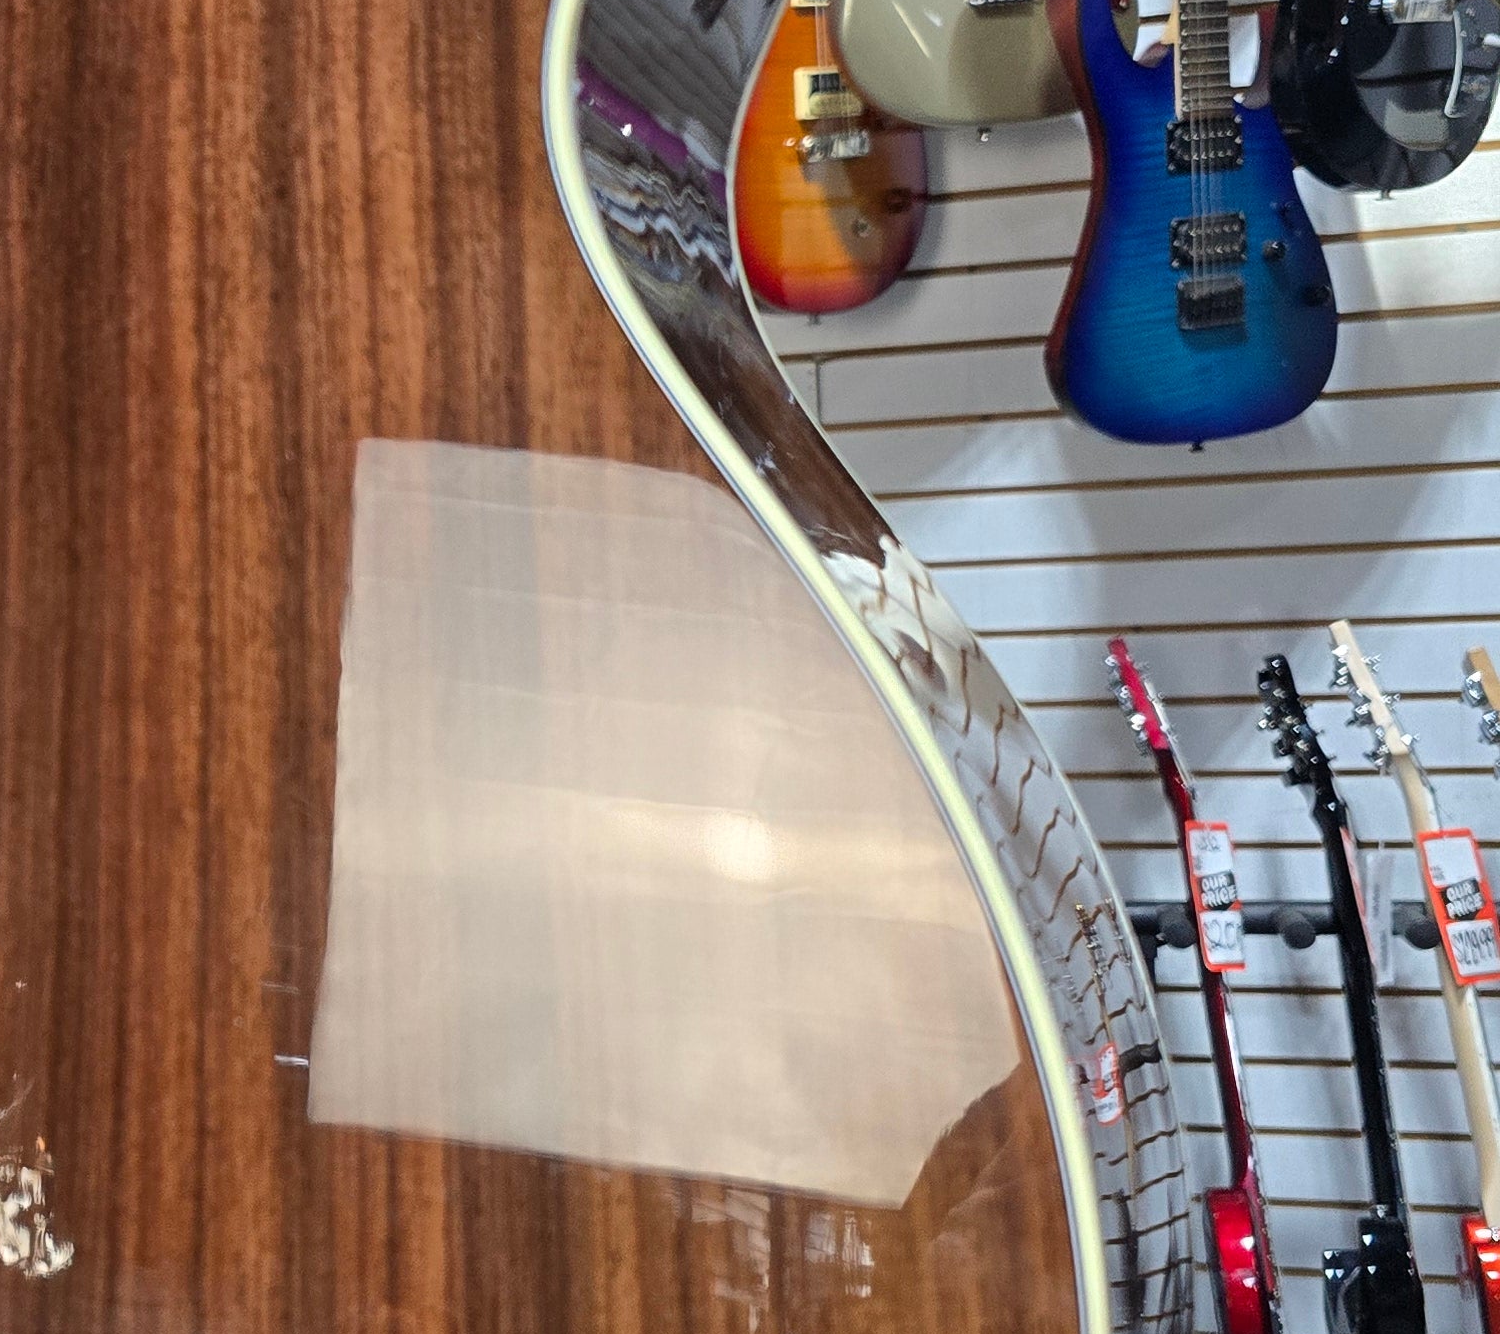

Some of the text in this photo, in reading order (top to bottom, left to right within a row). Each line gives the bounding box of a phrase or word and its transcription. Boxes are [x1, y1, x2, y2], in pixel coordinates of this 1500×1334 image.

[1201, 873, 1229, 892] OUR
[1446, 881, 1475, 902] OUR
[1201, 884, 1238, 909] PRICE
[1445, 892, 1485, 920] PRICE
